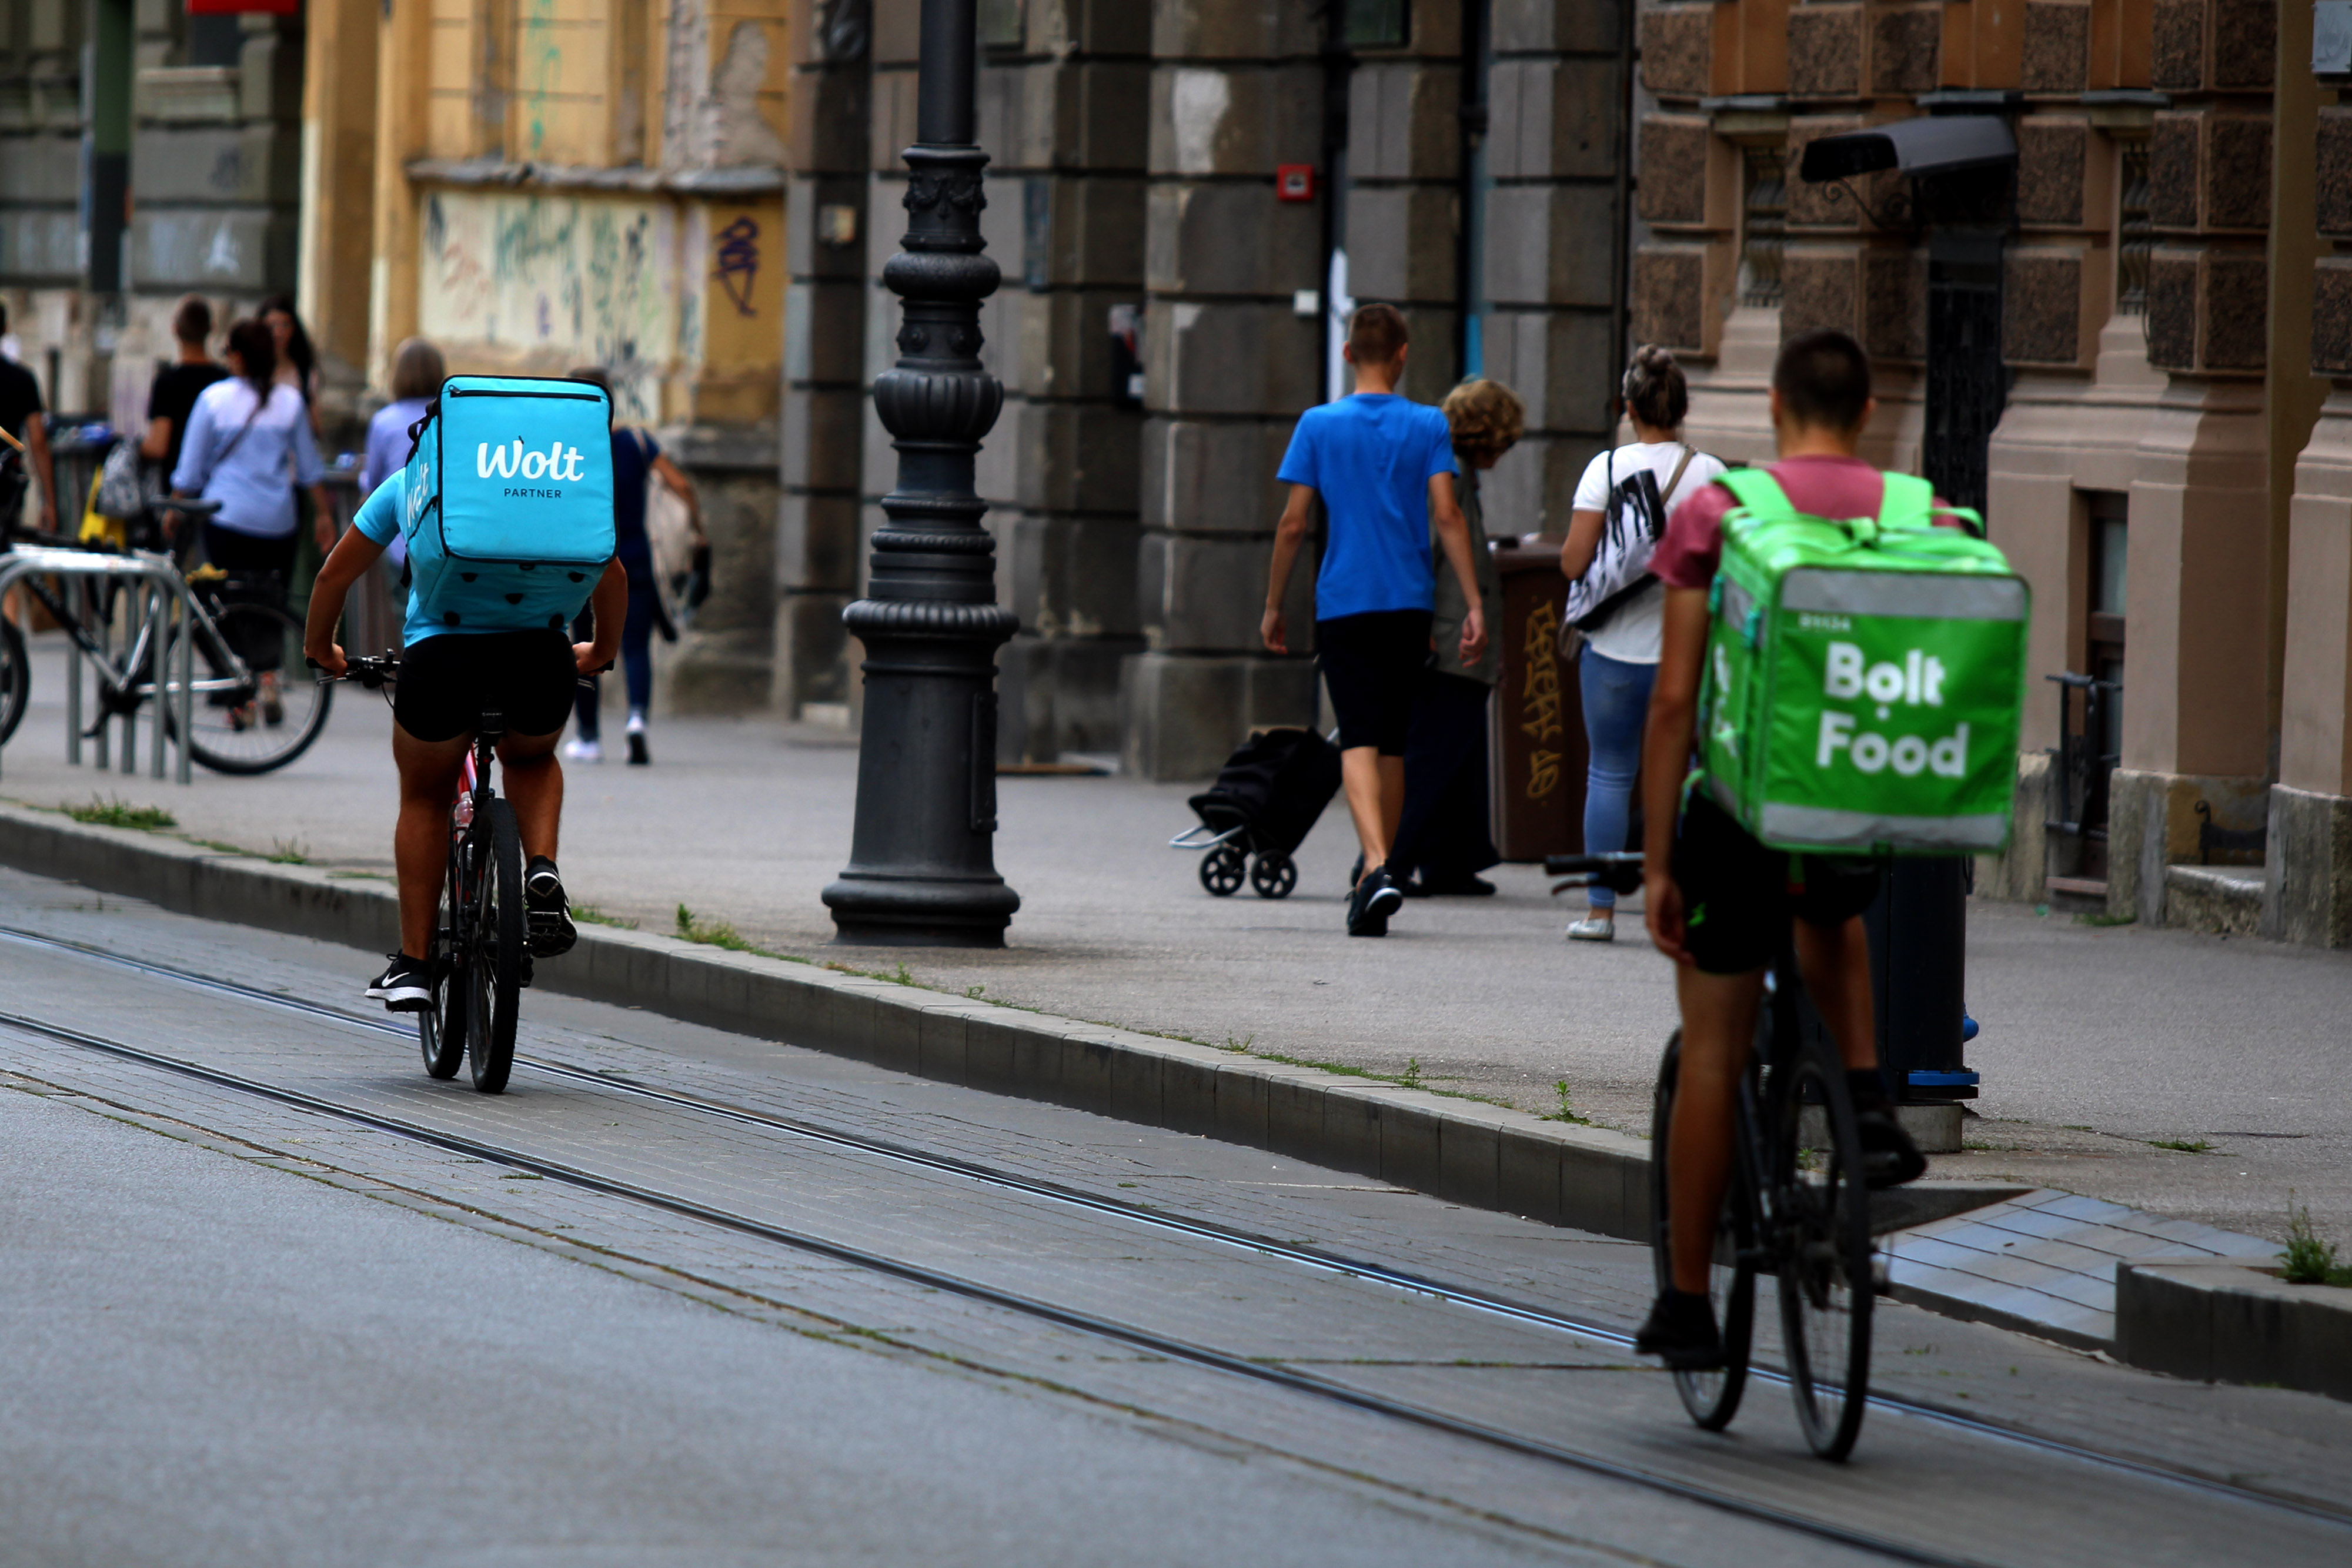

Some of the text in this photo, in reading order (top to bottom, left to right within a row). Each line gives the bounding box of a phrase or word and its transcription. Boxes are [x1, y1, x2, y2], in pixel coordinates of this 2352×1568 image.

[477, 440, 584, 482] Wolt
[504, 488, 562, 498] PARTNER
[1825, 641, 1945, 706] Bolt
[1817, 710, 1969, 778] Food
